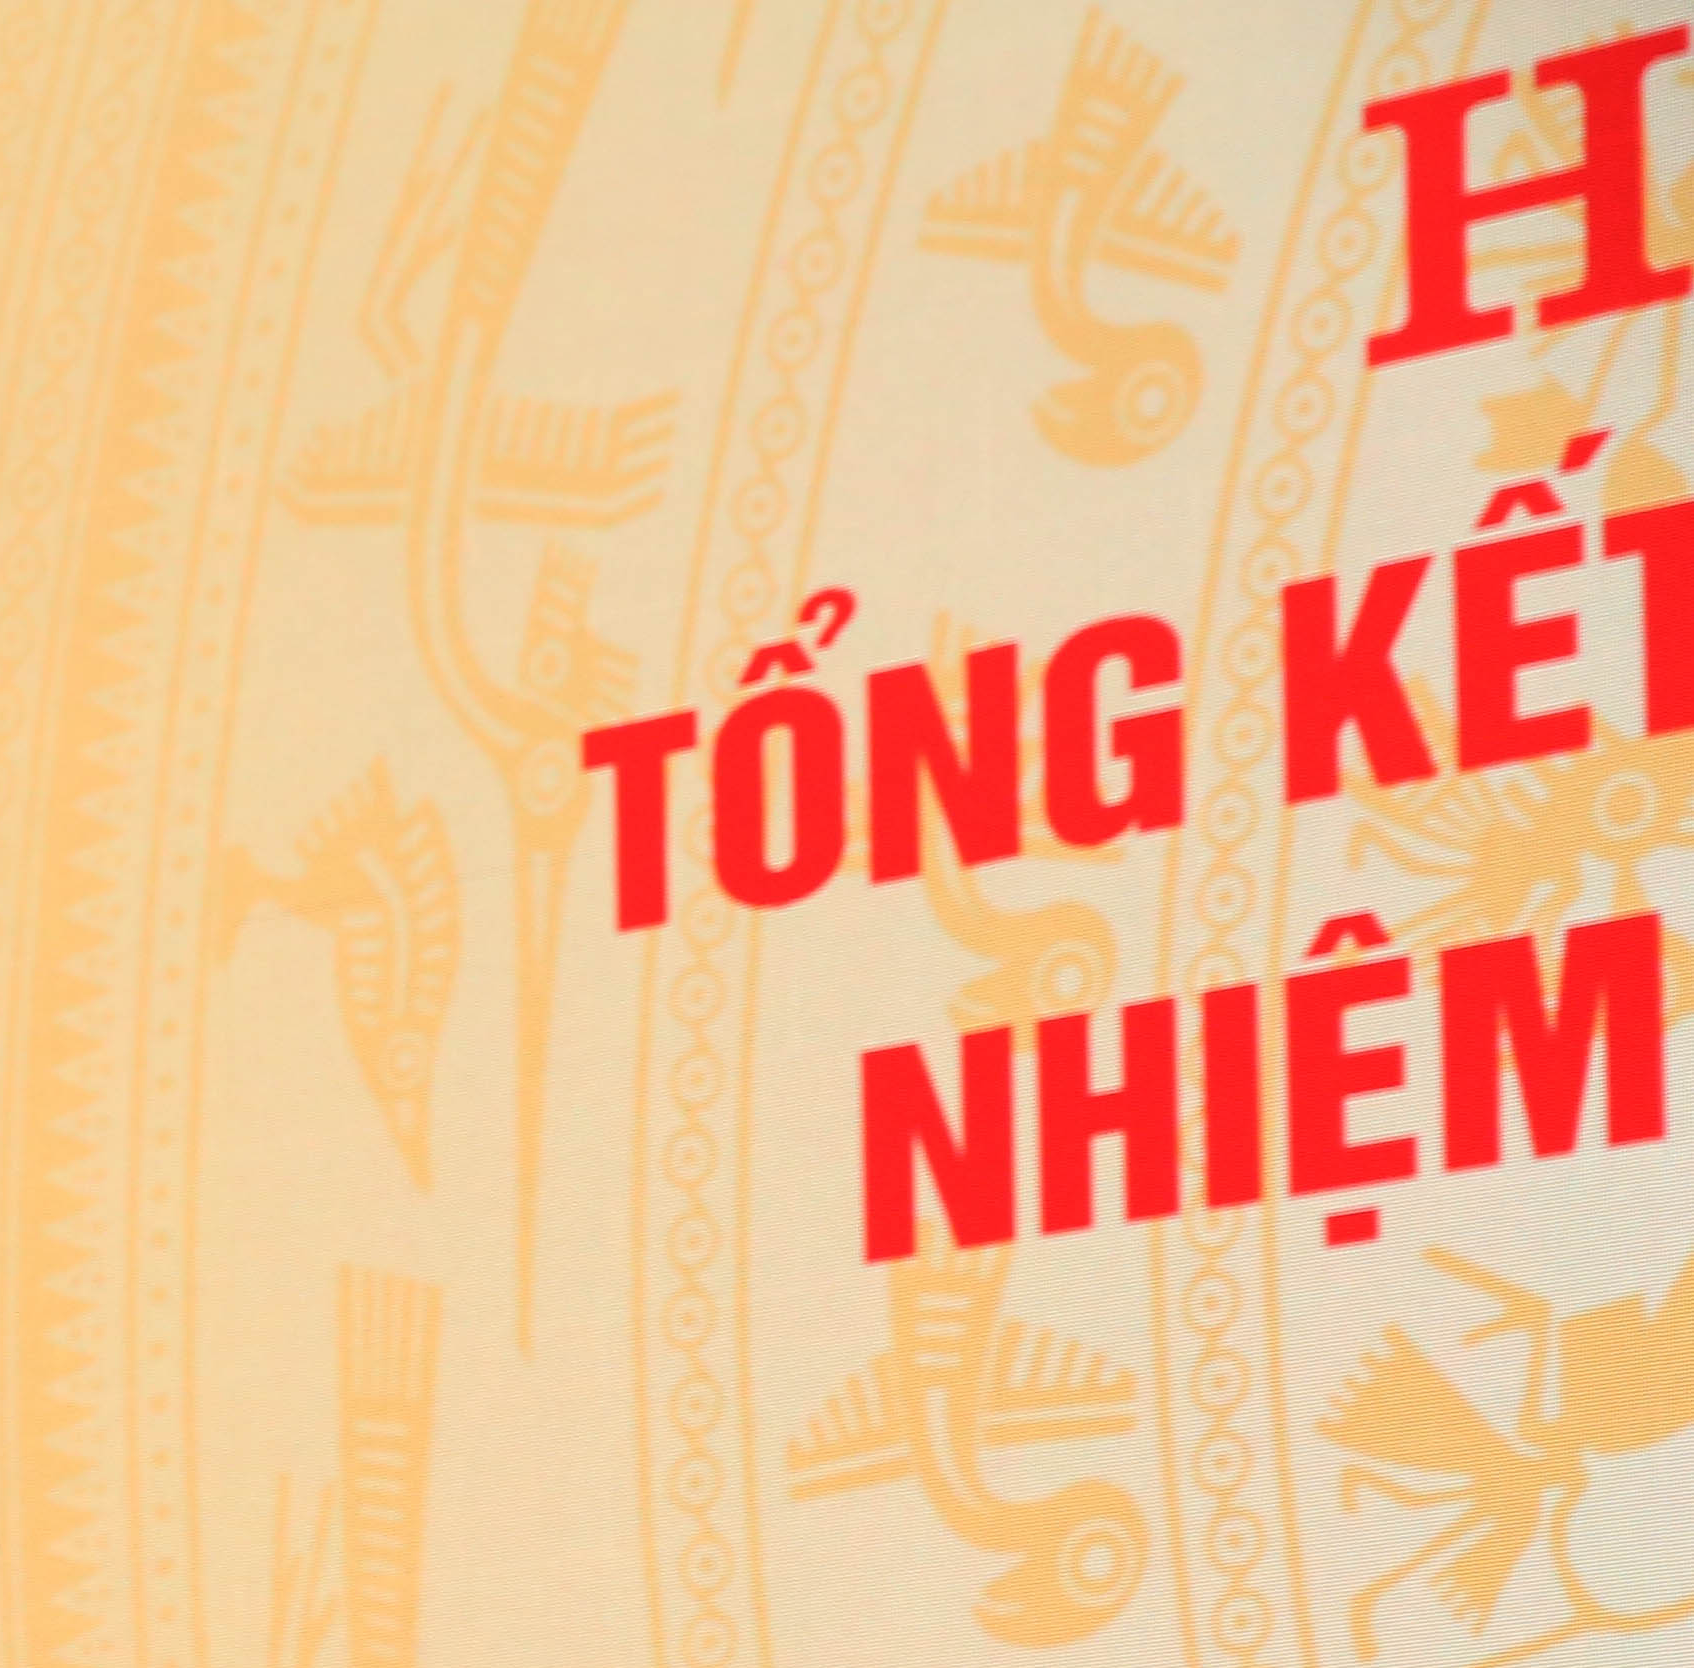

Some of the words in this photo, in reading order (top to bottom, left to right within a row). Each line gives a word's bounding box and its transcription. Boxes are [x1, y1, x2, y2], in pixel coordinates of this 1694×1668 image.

[1360, 20, 1694, 369] H
[580, 586, 1185, 932] TỔNG
[1280, 428, 1694, 806] KẾT
[860, 909, 1668, 1264] NHIỆM
